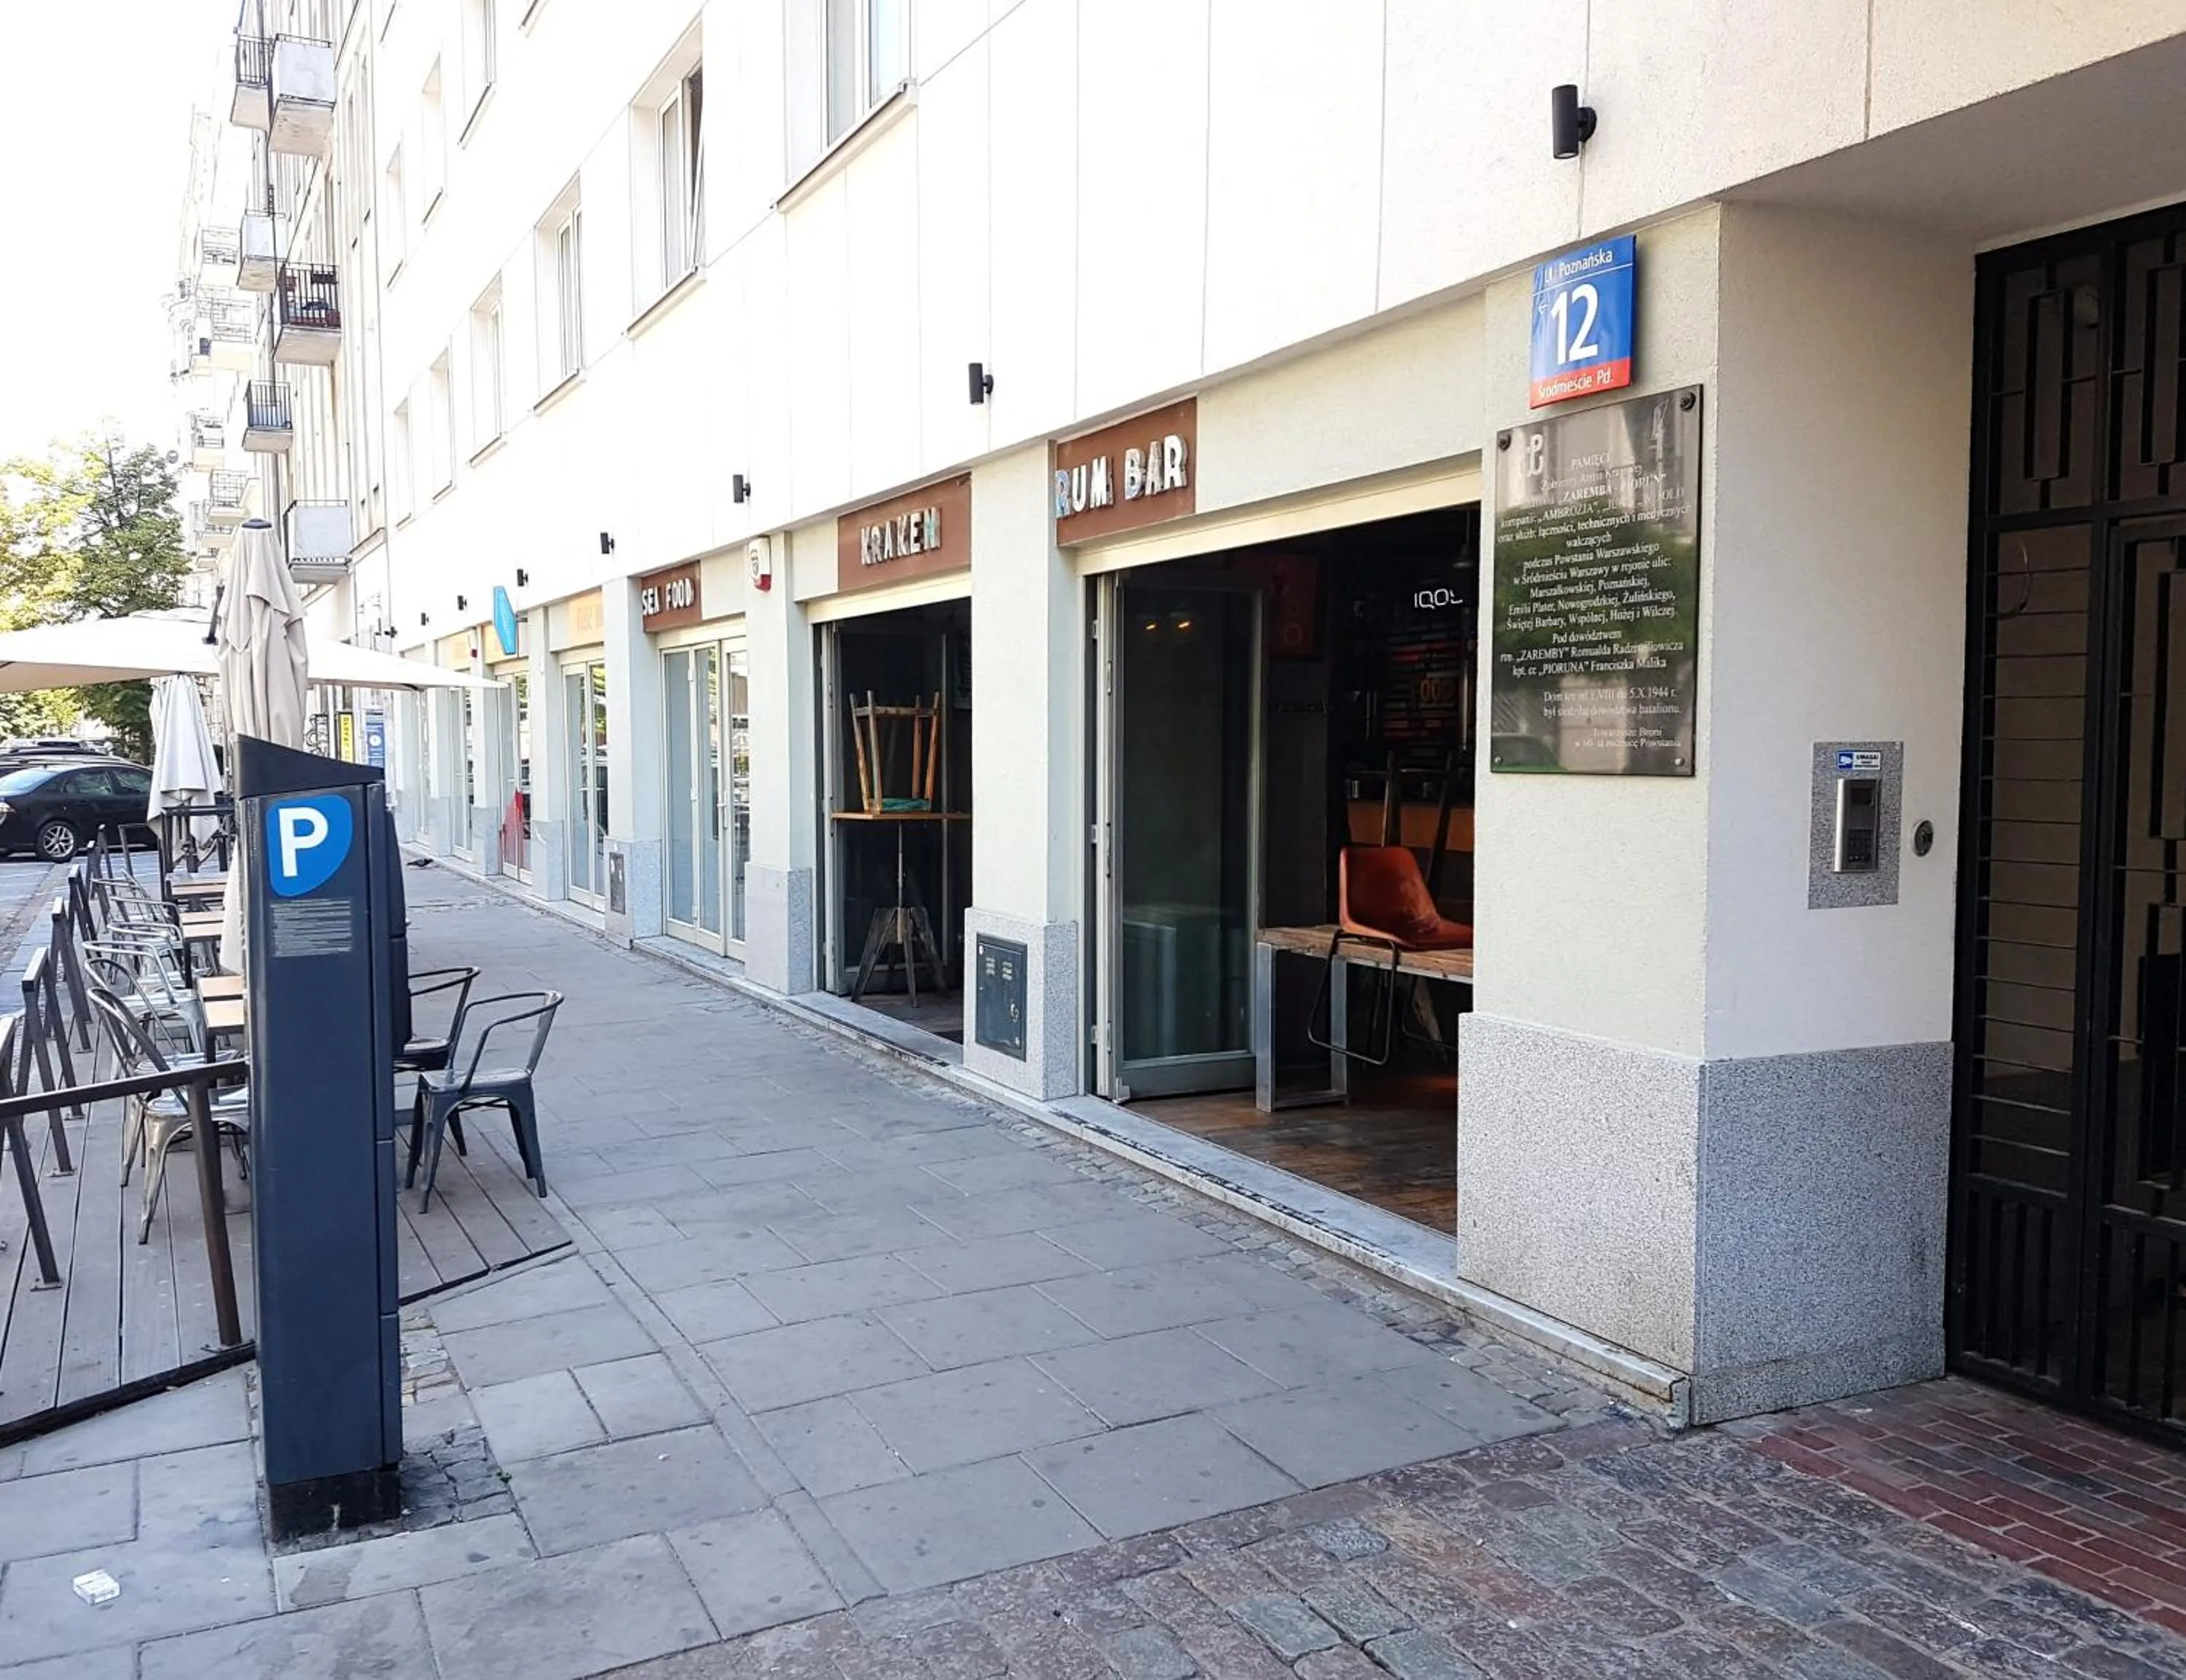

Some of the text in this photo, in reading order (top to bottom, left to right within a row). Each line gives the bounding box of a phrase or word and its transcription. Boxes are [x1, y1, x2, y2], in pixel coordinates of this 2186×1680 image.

[1559, 248, 1613, 278] Poznańska
[1551, 283, 1598, 365] 12
[1597, 366, 1615, 385] Pd.
[1055, 435, 1188, 518] RUM BAR
[1578, 513, 1629, 533] technicznych
[861, 507, 941, 565] KRAKEN
[1566, 531, 1612, 550] walczących
[1522, 554, 1552, 573] podczas
[1596, 539, 1660, 561] Warszawskiego
[1569, 563, 1608, 581] Warszawy
[641, 578, 694, 616] SEA FOOD
[1552, 632, 1567, 643] Pod
[1591, 658, 1634, 671] Franciszka
[1544, 691, 1562, 702] Dom
[1543, 706, 1556, 719] był
[279, 806, 329, 877] P
